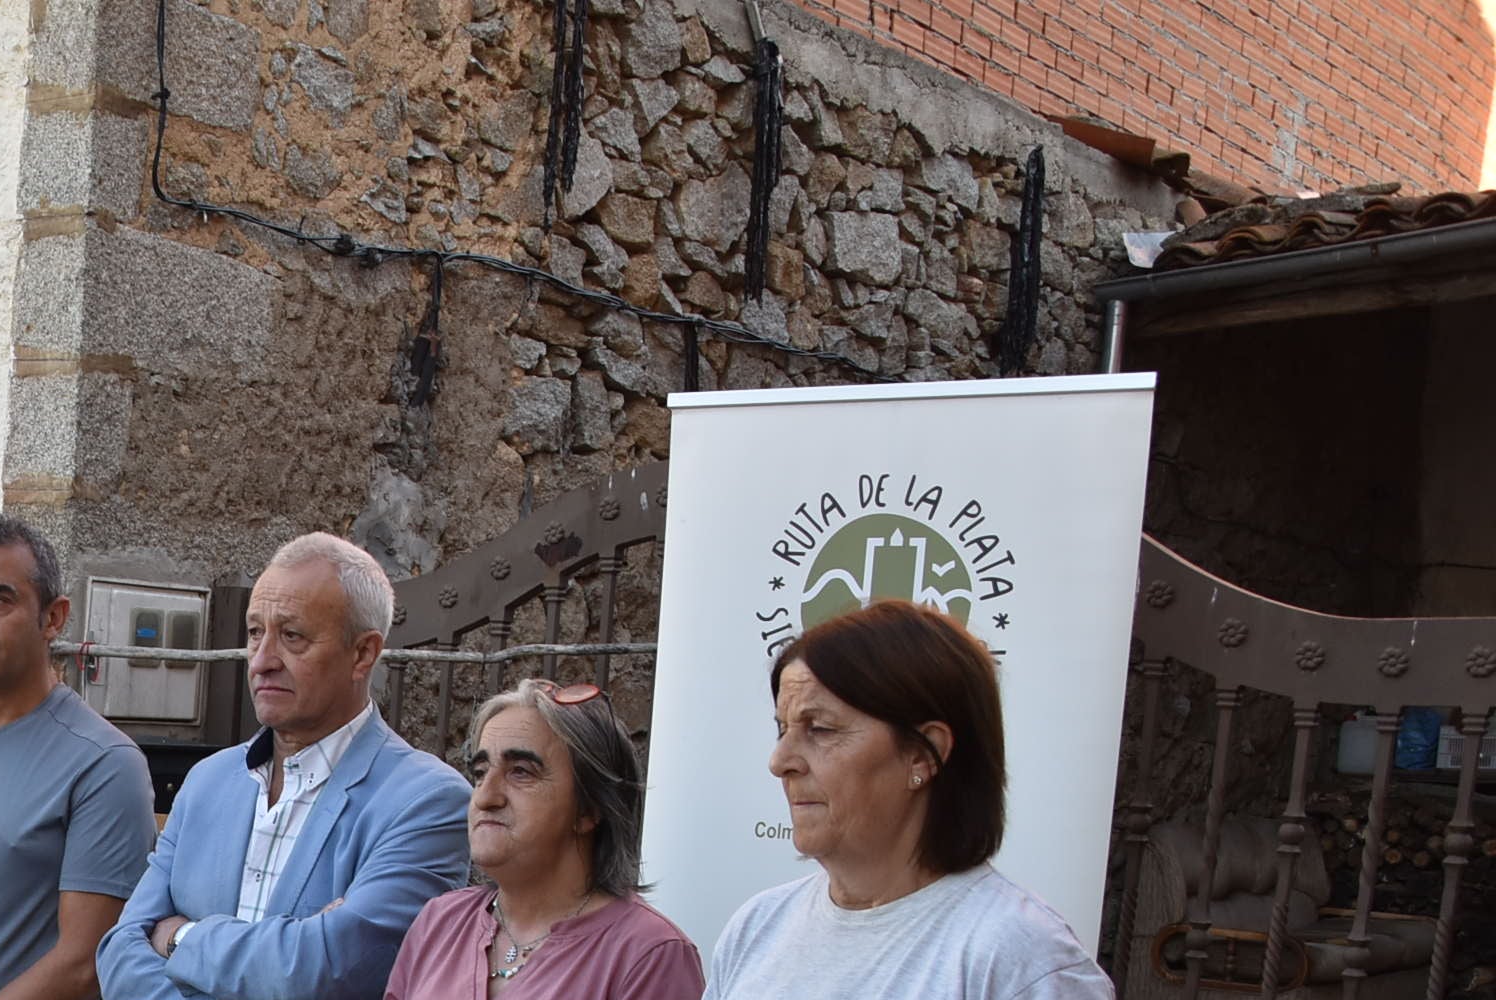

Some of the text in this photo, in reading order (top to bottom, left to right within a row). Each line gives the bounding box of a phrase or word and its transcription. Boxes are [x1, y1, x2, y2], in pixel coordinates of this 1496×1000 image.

[772, 474, 1015, 600] RUTA DE LA PLATA
